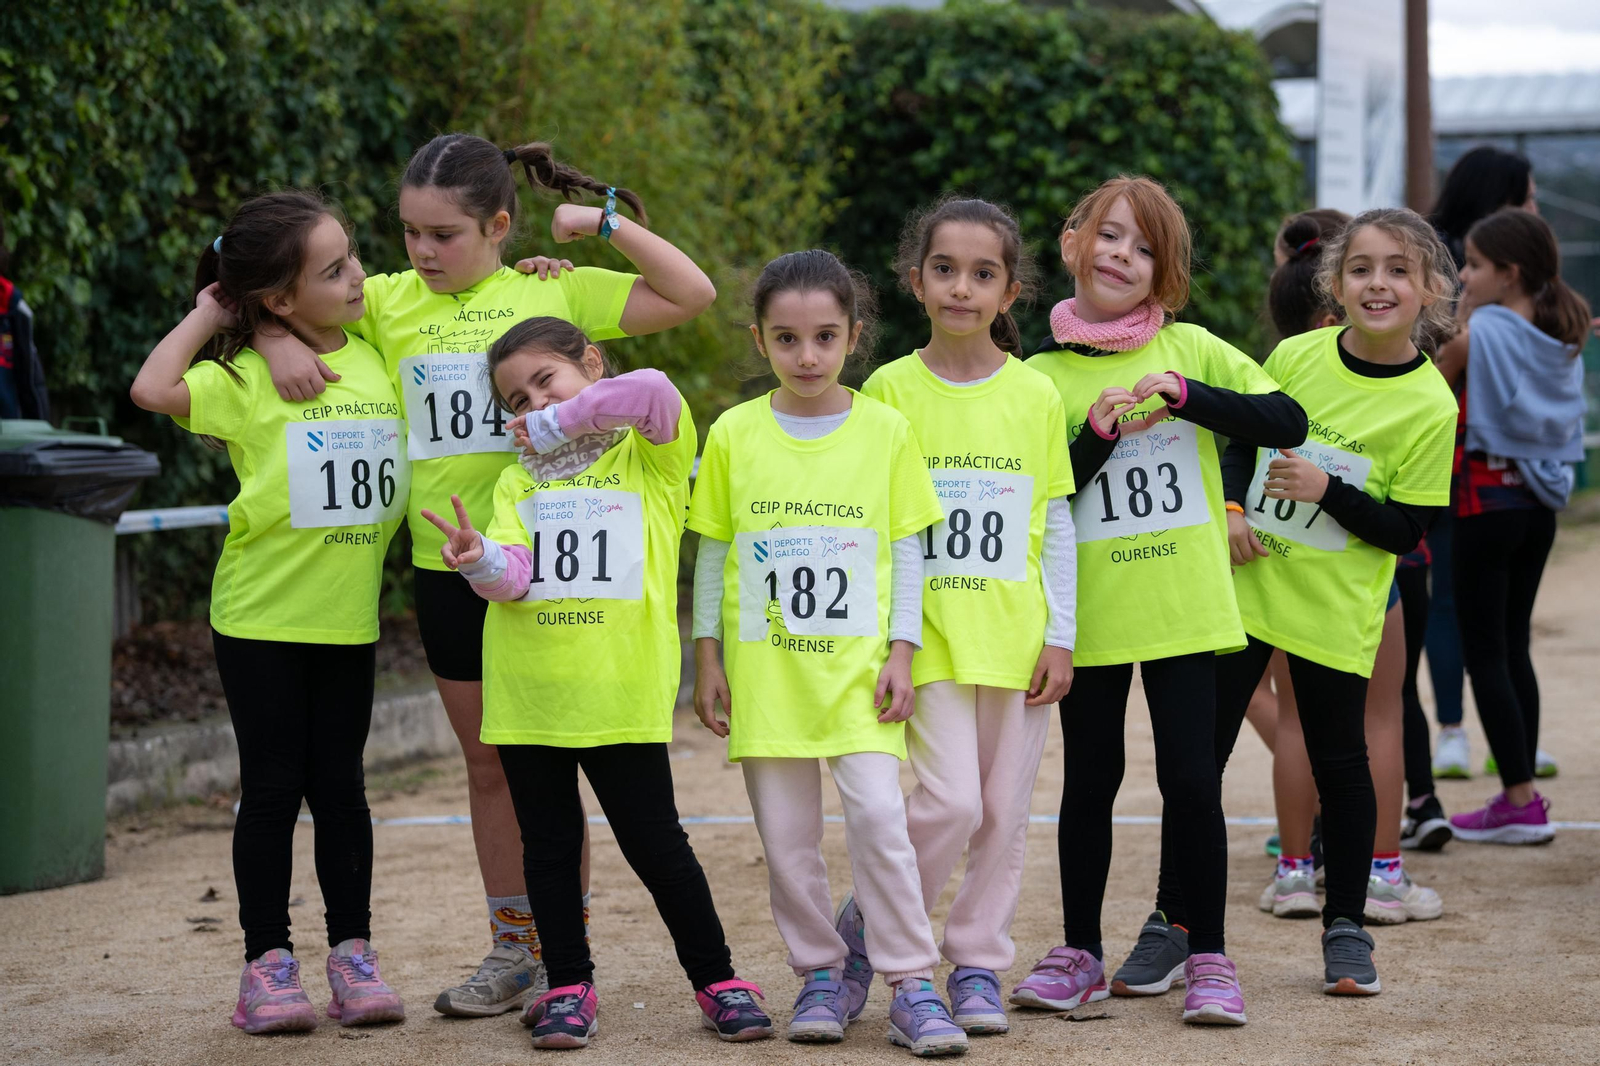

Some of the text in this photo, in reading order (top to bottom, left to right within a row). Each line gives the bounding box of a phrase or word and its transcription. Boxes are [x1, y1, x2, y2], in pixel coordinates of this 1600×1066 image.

[451, 307, 514, 322] ÁCTICAS
[431, 363, 470, 373] DEPORTE
[431, 373, 467, 383] GALEGO
[303, 400, 398, 420] CEIP PRÁCTICAS
[424, 390, 507, 443] 184
[331, 430, 365, 440] DEPORTE
[331, 440, 364, 450] GALEGO
[923, 452, 1022, 471] IP PRÁCTICAS
[1107, 449, 1139, 460] ALEGO
[320, 458, 396, 511] 186
[932, 480, 971, 489] DEPORTE
[935, 490, 967, 499] ALEGO
[1094, 462, 1183, 523] 183
[539, 500, 577, 511] DEPORTE
[751, 500, 864, 519] CEIP PRÁCTICAS
[539, 510, 574, 521] GALEGO
[924, 508, 1004, 563] 188
[1250, 526, 1292, 558] RENSE
[774, 538, 813, 548] DEPORTE
[530, 529, 612, 584] 181
[775, 548, 810, 558] GALEGO
[1111, 542, 1177, 563] OURENSE
[765, 566, 848, 620] 182
[537, 611, 605, 625] OURENSE
